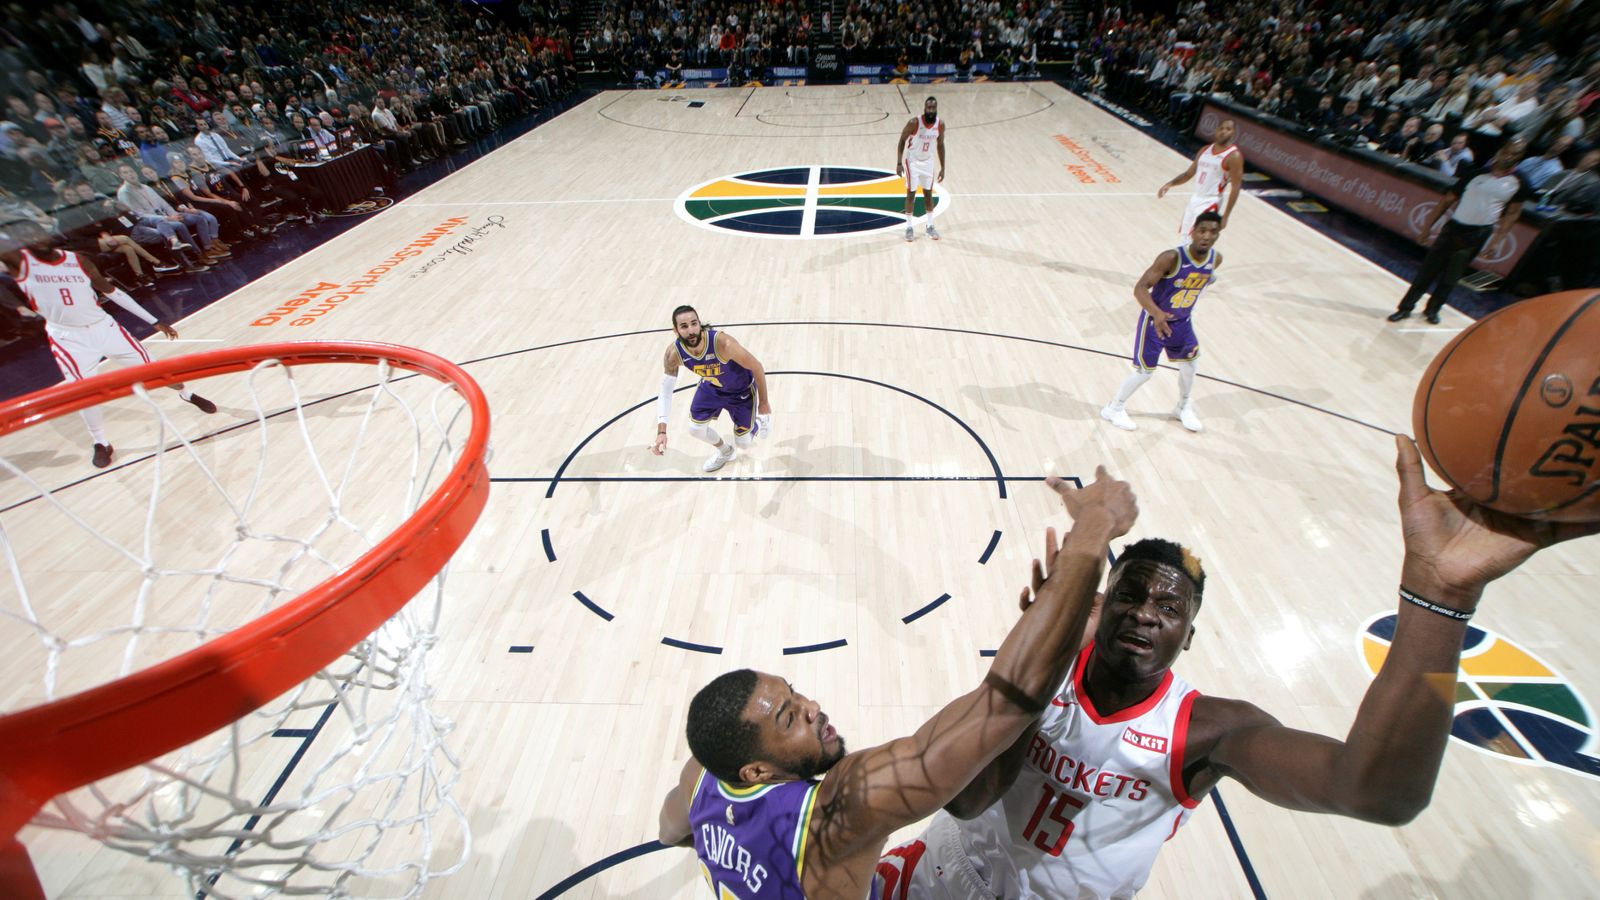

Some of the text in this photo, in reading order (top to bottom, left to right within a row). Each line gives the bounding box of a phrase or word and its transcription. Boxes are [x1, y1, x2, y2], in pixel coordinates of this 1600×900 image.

[1342, 177, 1360, 193] of
[1356, 182, 1377, 203] the
[1375, 190, 1407, 214] NBA
[34, 274, 86, 284] ROCKETS
[59, 287, 74, 306] 8
[249, 281, 342, 328] Arena
[1170, 289, 1201, 309] 45
[1413, 597, 1430, 608] NOW
[1430, 605, 1455, 617] SHINE
[1026, 731, 1152, 802] ROCKETS
[1022, 782, 1085, 858] 15
[701, 823, 768, 893] FAVORS
